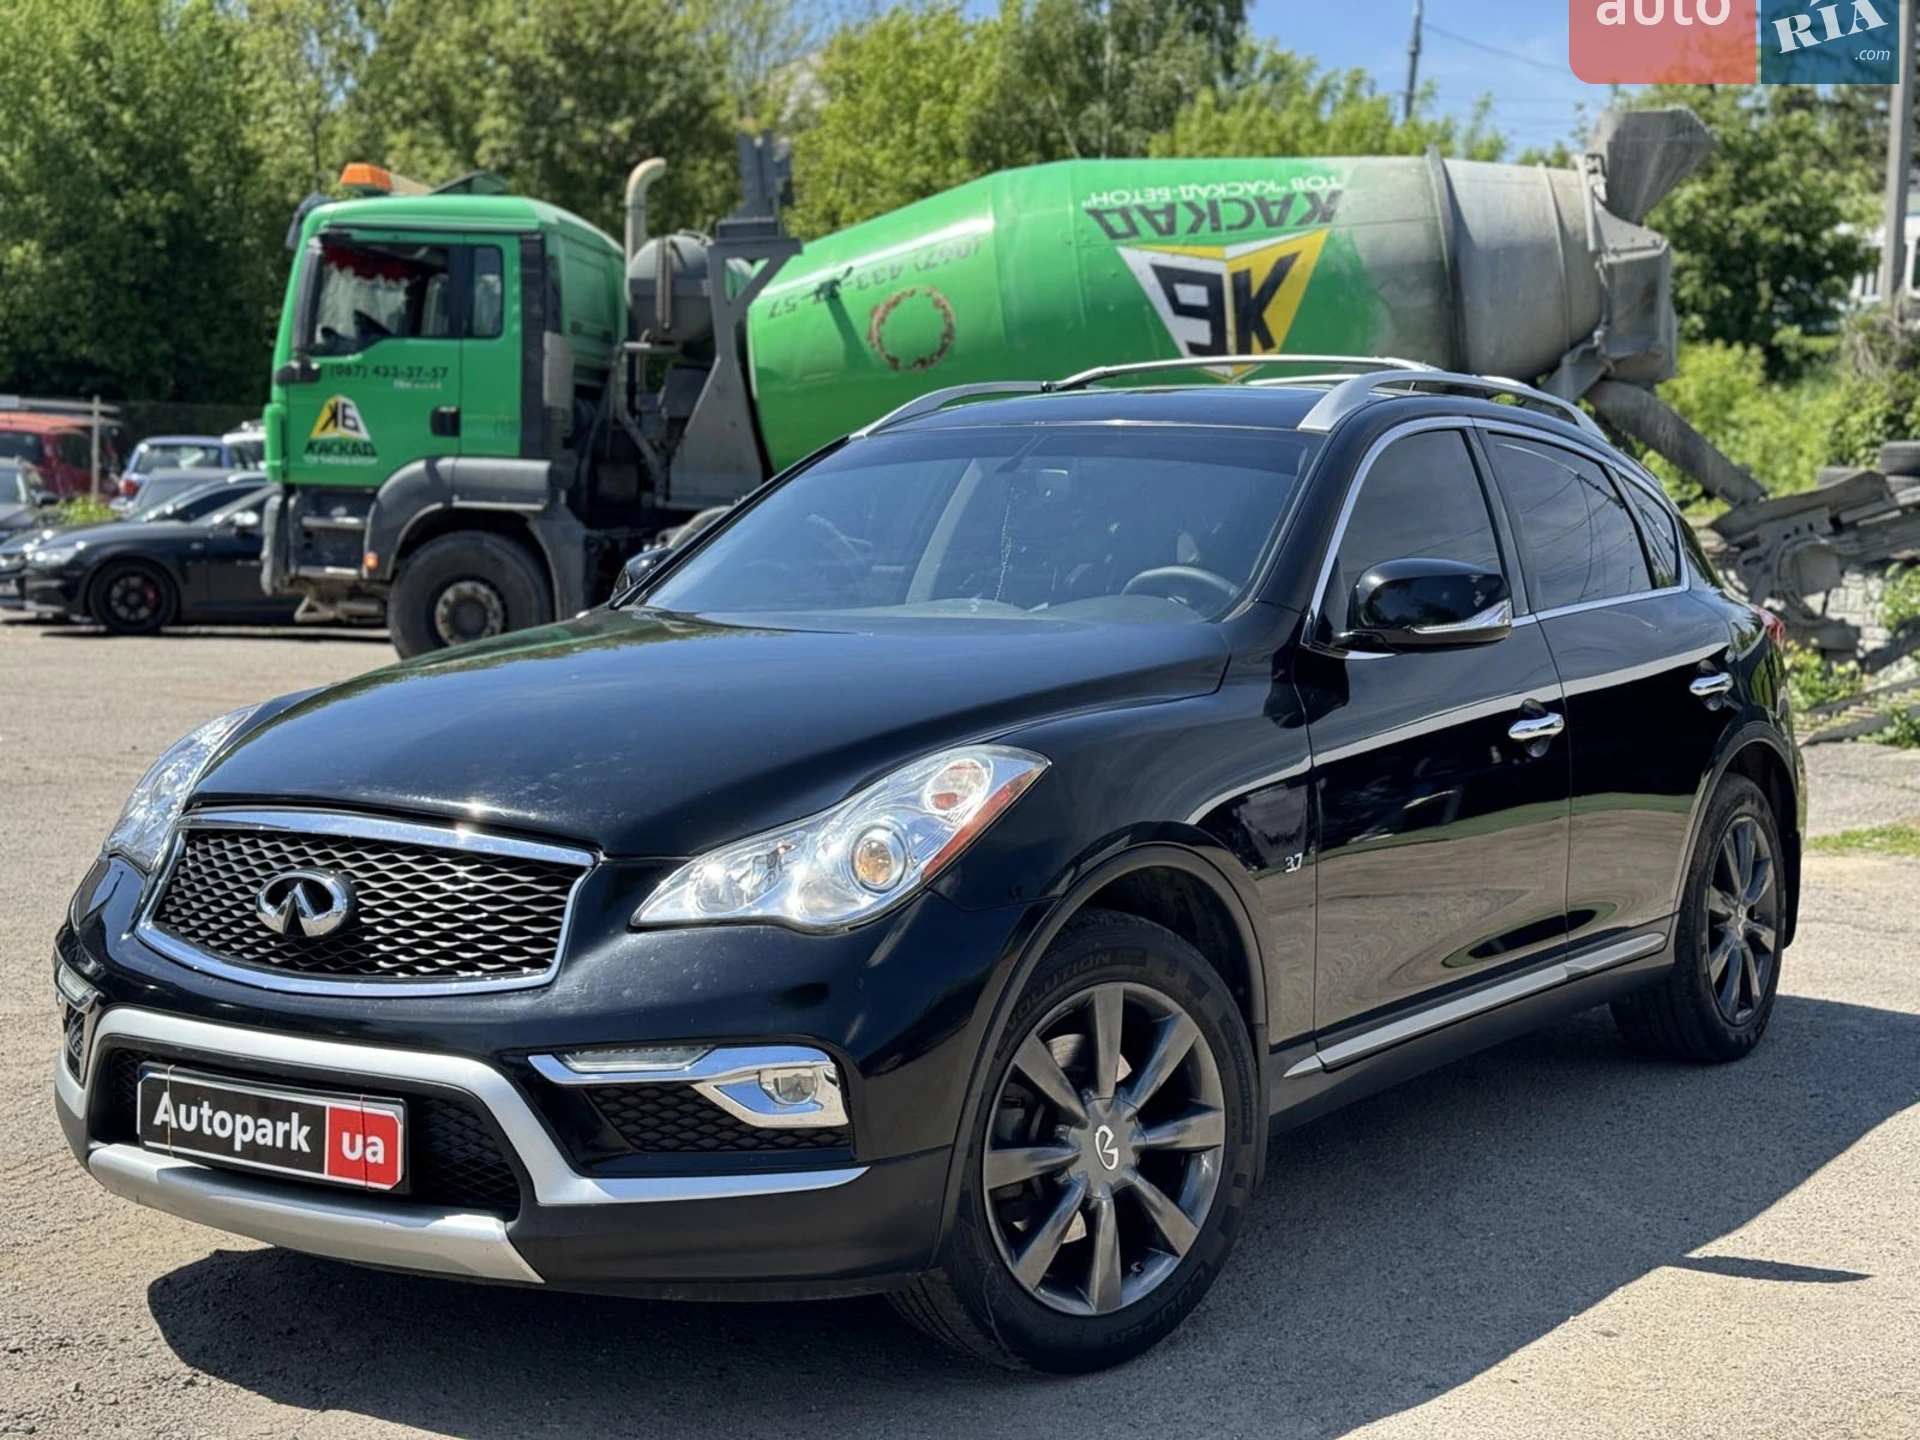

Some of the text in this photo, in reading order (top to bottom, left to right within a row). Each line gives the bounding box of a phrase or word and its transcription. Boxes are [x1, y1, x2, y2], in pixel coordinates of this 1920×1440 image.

[1085, 189, 1343, 241] КАСКАД
[304, 440, 377, 457] КАСКАД
[153, 1091, 385, 1164] Autopark ua
